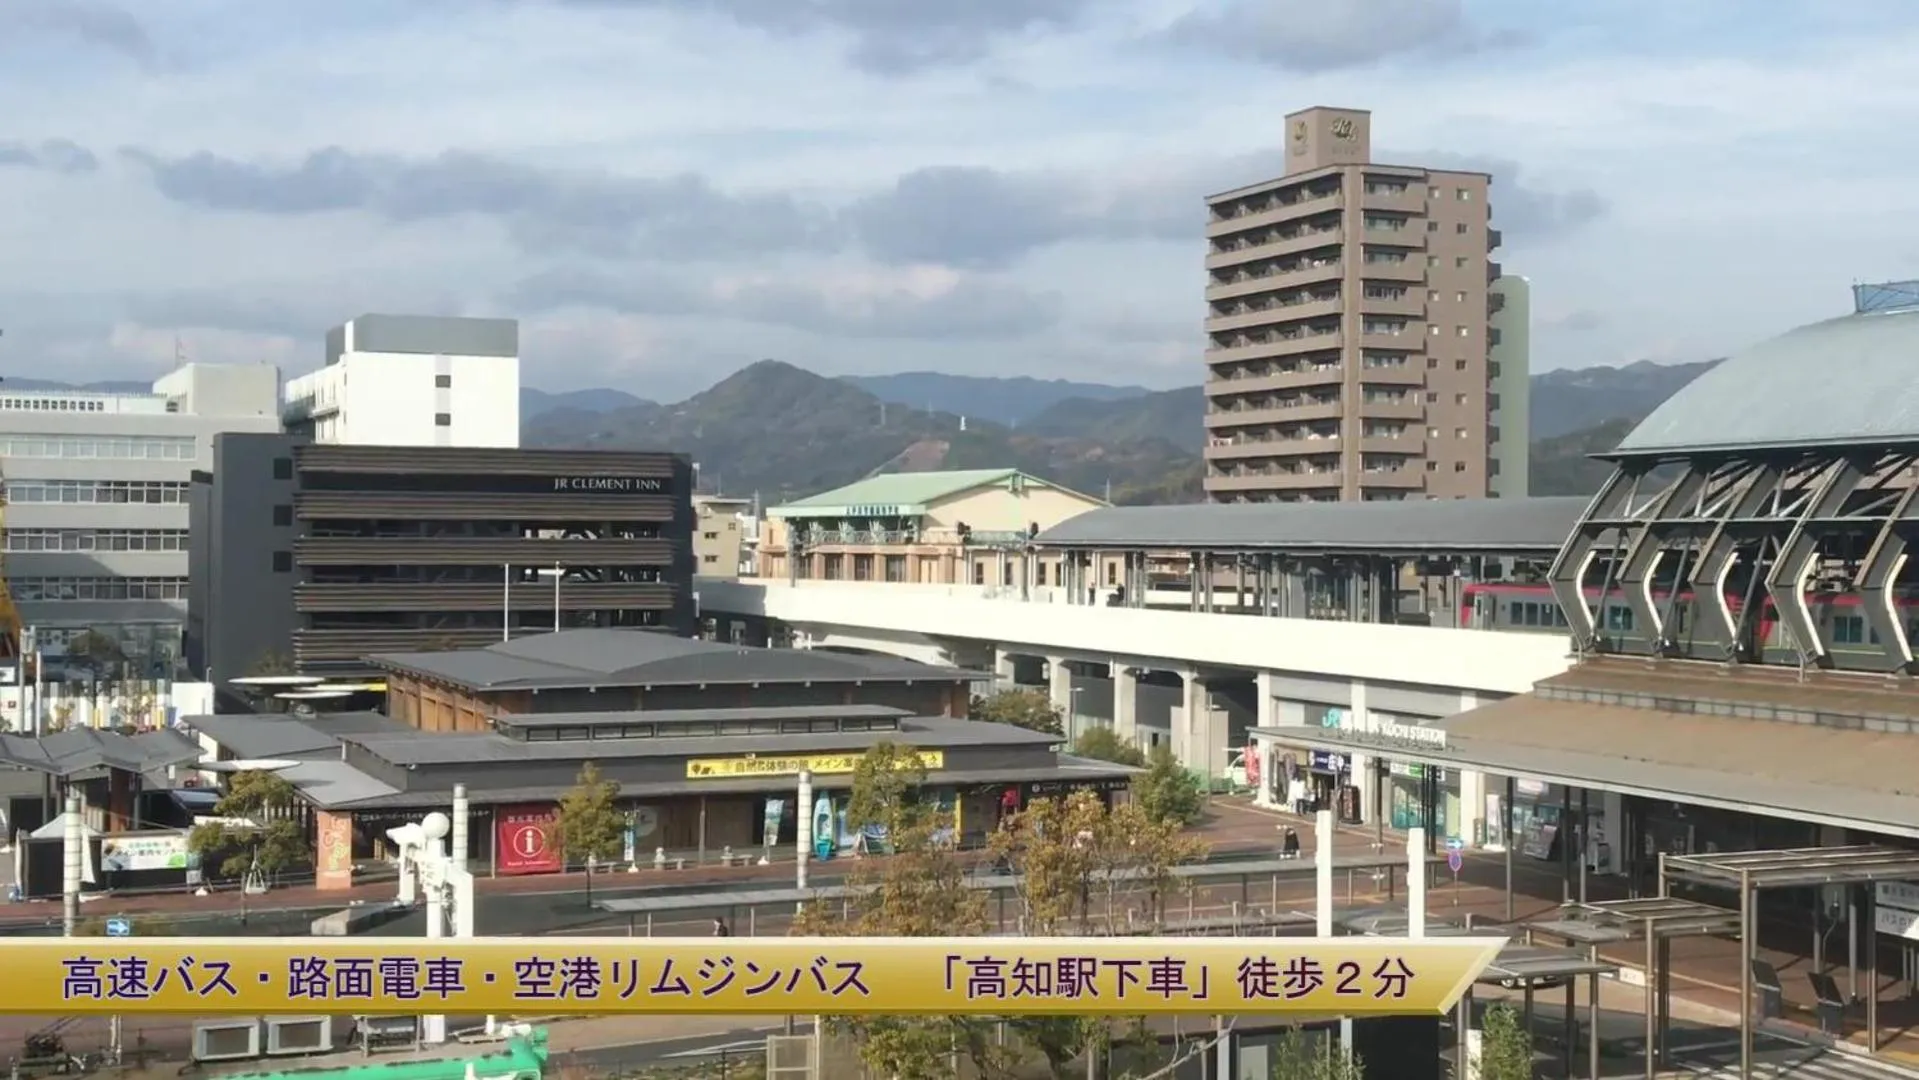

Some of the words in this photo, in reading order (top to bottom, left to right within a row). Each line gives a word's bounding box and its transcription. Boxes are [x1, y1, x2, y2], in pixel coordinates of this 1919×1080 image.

[554, 477, 568, 490] JR
[571, 477, 631, 490] CLEMENT
[635, 478, 661, 490] INN
